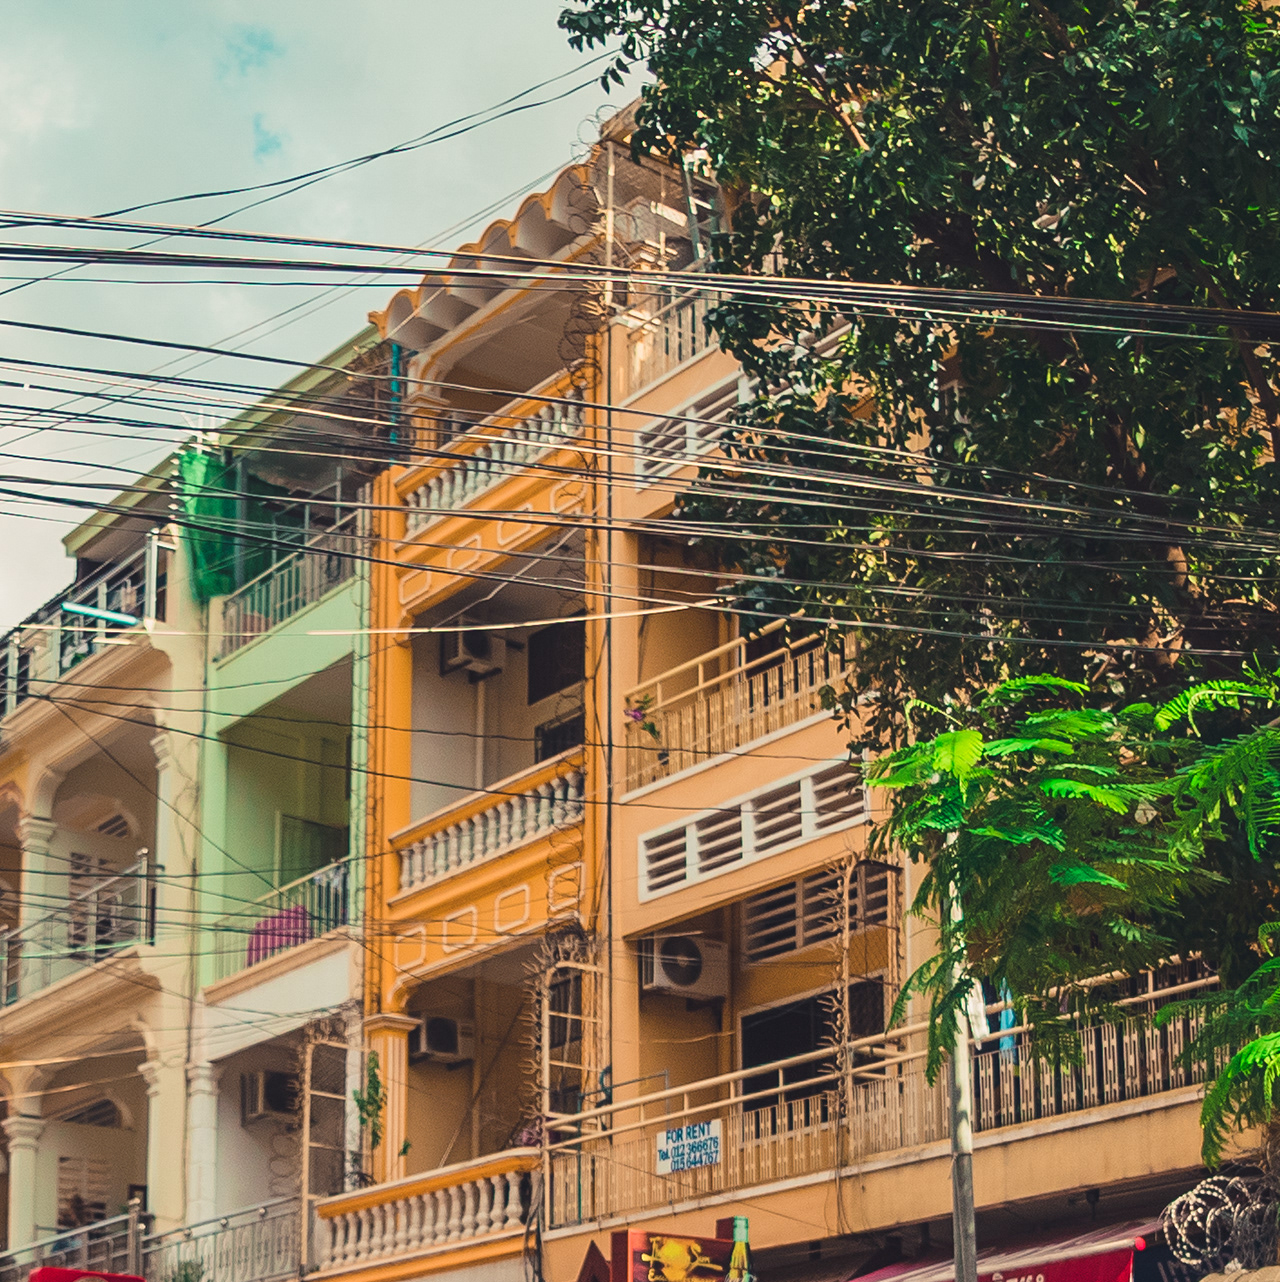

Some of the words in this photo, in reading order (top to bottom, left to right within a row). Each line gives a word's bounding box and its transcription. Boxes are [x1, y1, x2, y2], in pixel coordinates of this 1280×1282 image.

[666, 1128, 683, 1145] FOR
[686, 1121, 711, 1140] RENT
[671, 1144, 685, 1159] 012
